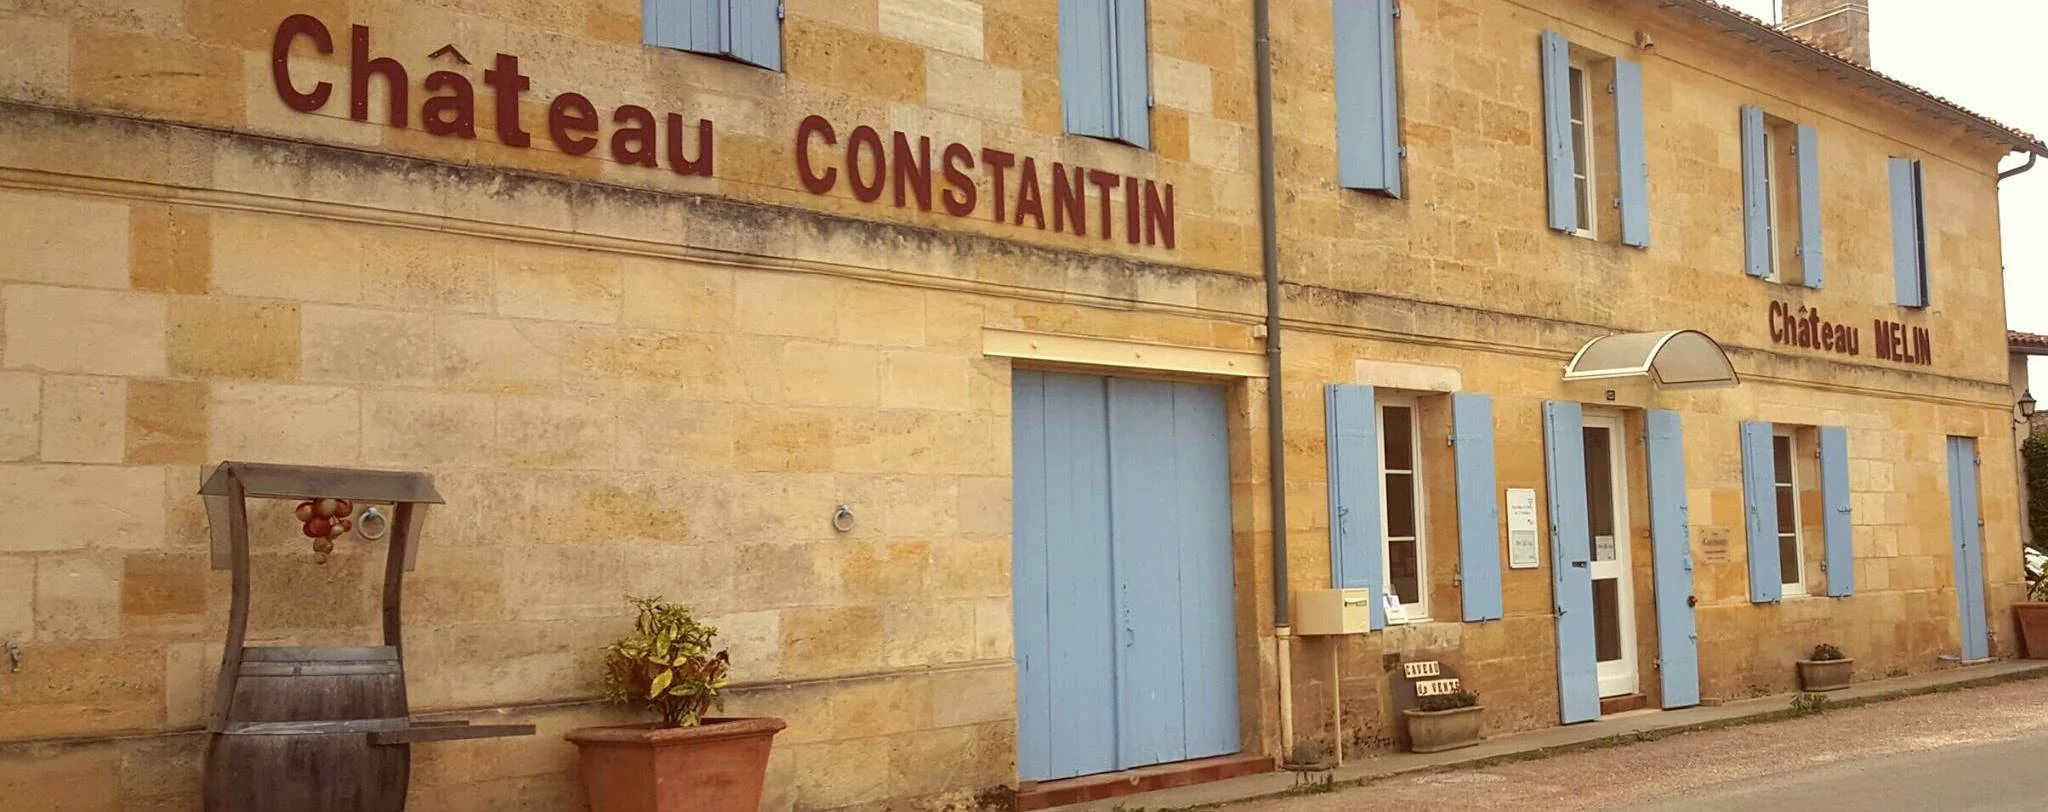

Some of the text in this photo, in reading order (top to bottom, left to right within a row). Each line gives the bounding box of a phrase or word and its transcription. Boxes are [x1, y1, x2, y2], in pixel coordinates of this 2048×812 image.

[272, 13, 1175, 249] Château CONSTANTIN
[1768, 300, 1932, 366] Château MELIN
[1405, 663, 1439, 676] CAVEAU
